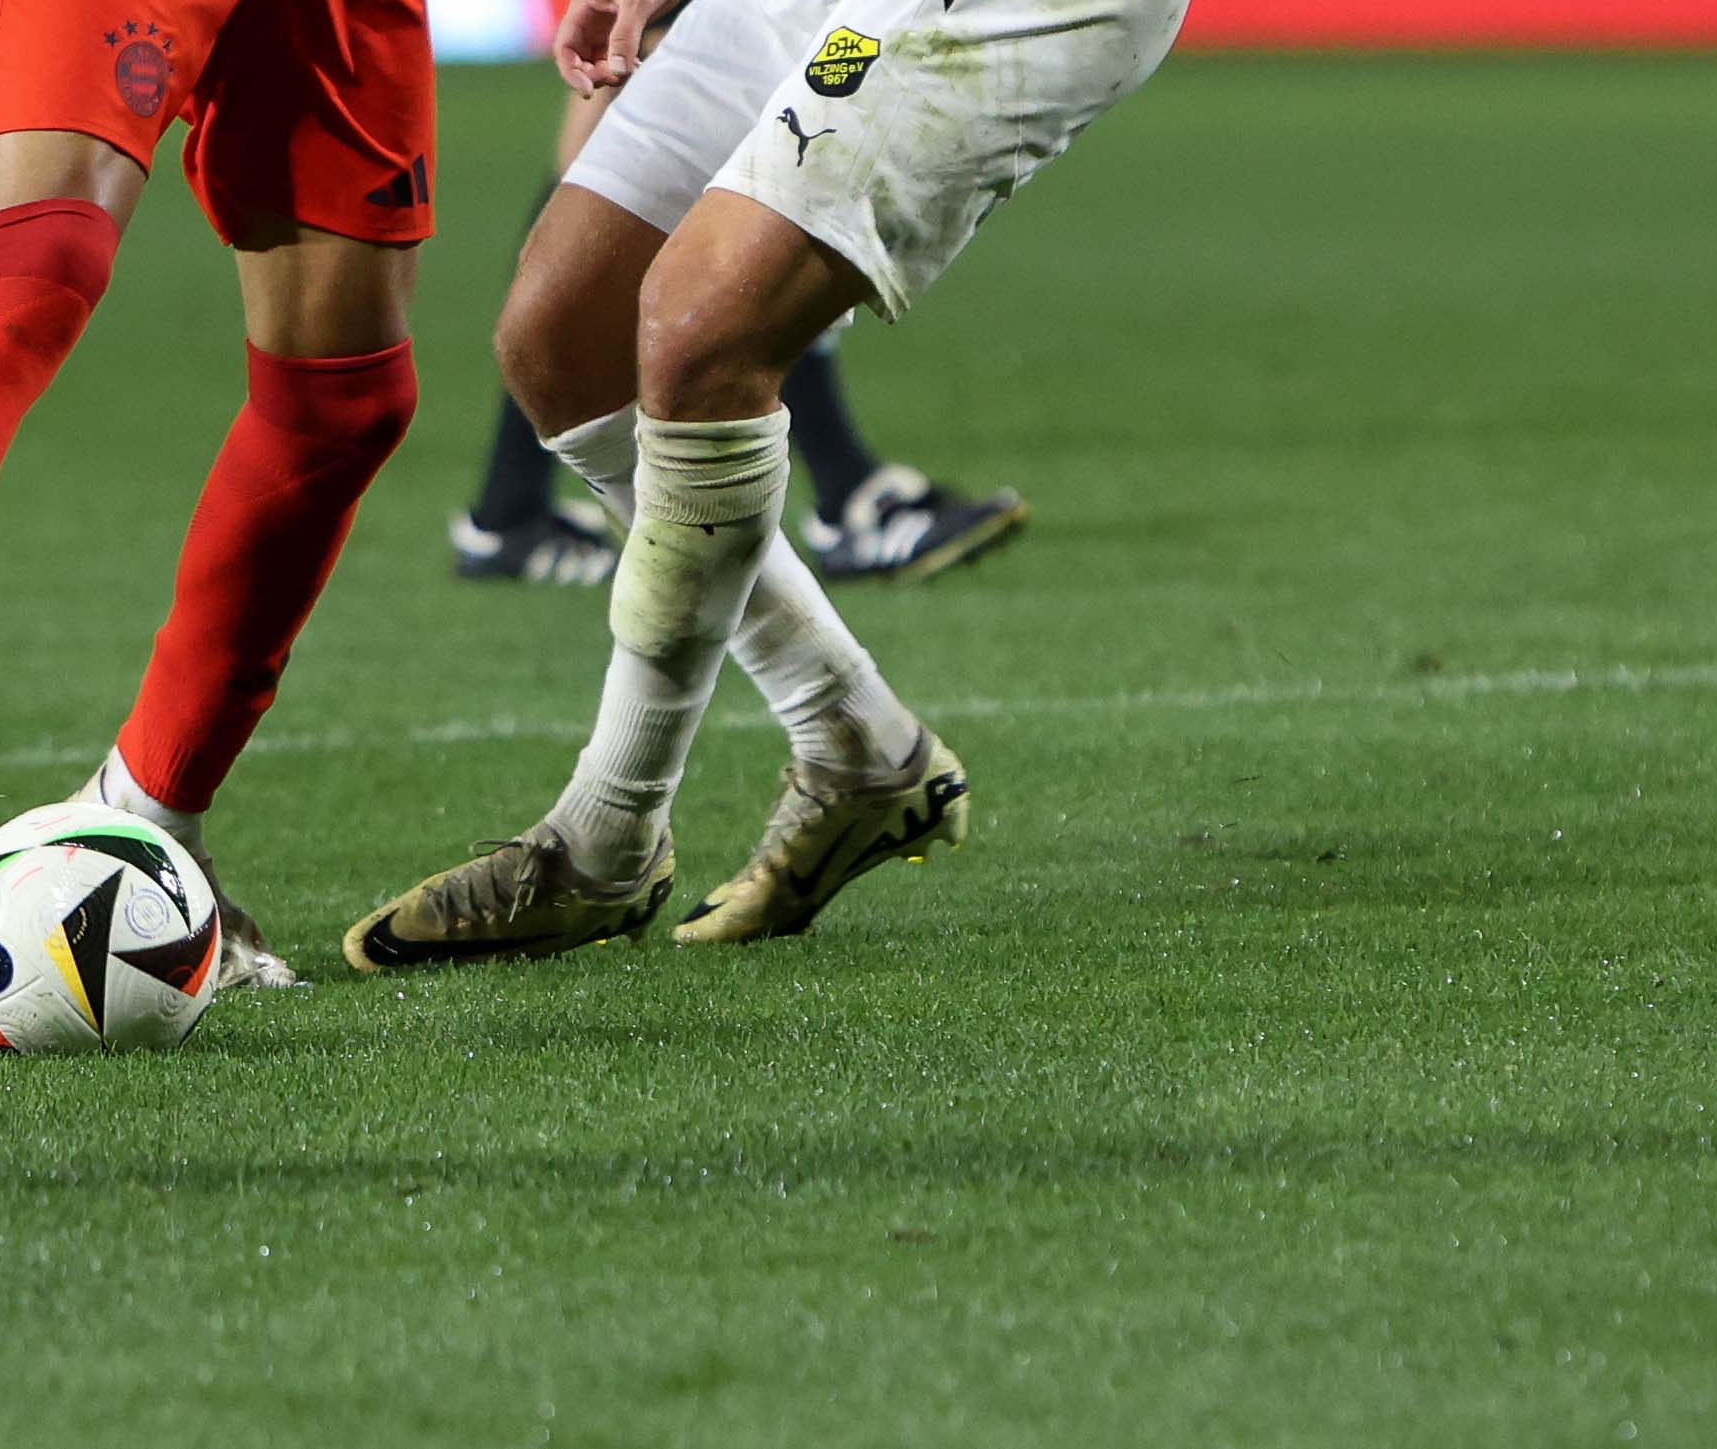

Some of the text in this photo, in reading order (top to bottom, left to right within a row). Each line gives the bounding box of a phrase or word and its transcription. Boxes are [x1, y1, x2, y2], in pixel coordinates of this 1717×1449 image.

[826, 37, 864, 58] DJK
[809, 62, 849, 76] VILZING
[822, 73, 849, 85] 1967
